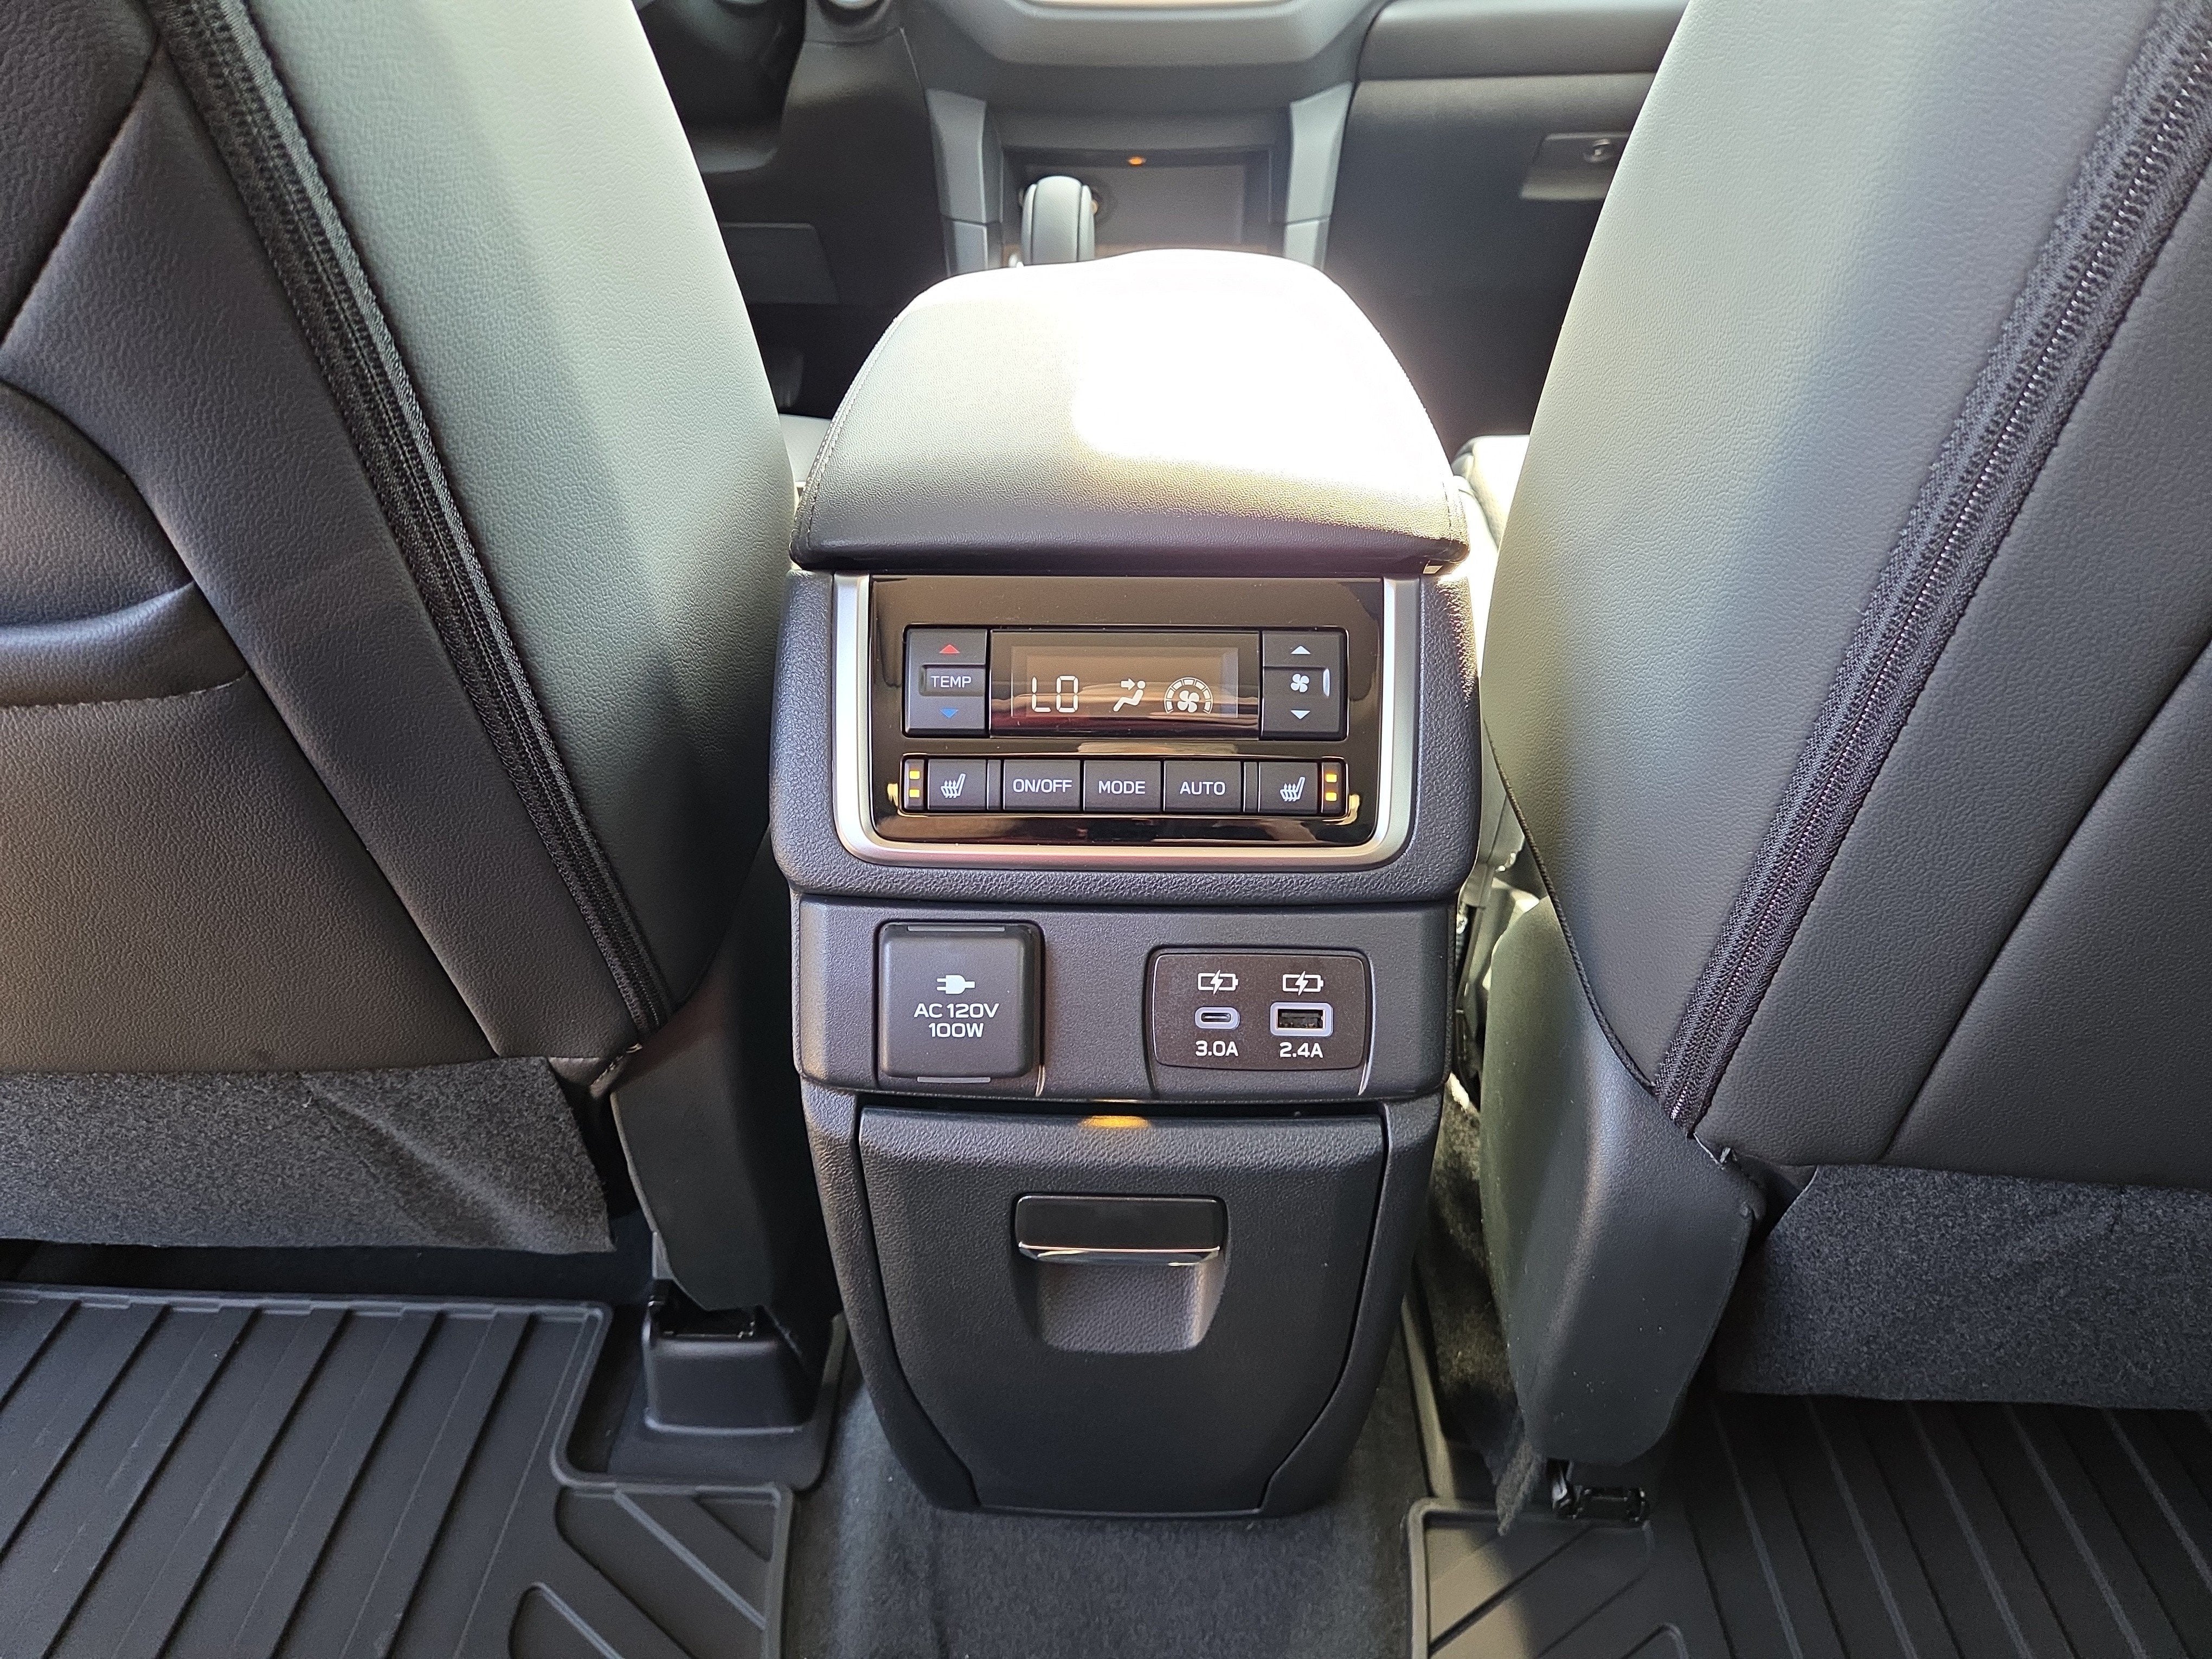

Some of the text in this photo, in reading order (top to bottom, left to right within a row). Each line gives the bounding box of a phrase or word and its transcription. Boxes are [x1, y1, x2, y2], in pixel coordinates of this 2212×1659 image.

[930, 675, 972, 689] TEMP
[1031, 676, 1079, 713] LO
[1012, 779, 1073, 795] ON/OFF
[1098, 780, 1146, 795] MODE
[1179, 781, 1226, 795] AUTO
[914, 1002, 1000, 1019] AC 120V
[928, 1022, 985, 1038] 100W
[1194, 1040, 1239, 1057] 3.0A
[1278, 1041, 1323, 1058] 2.4A
